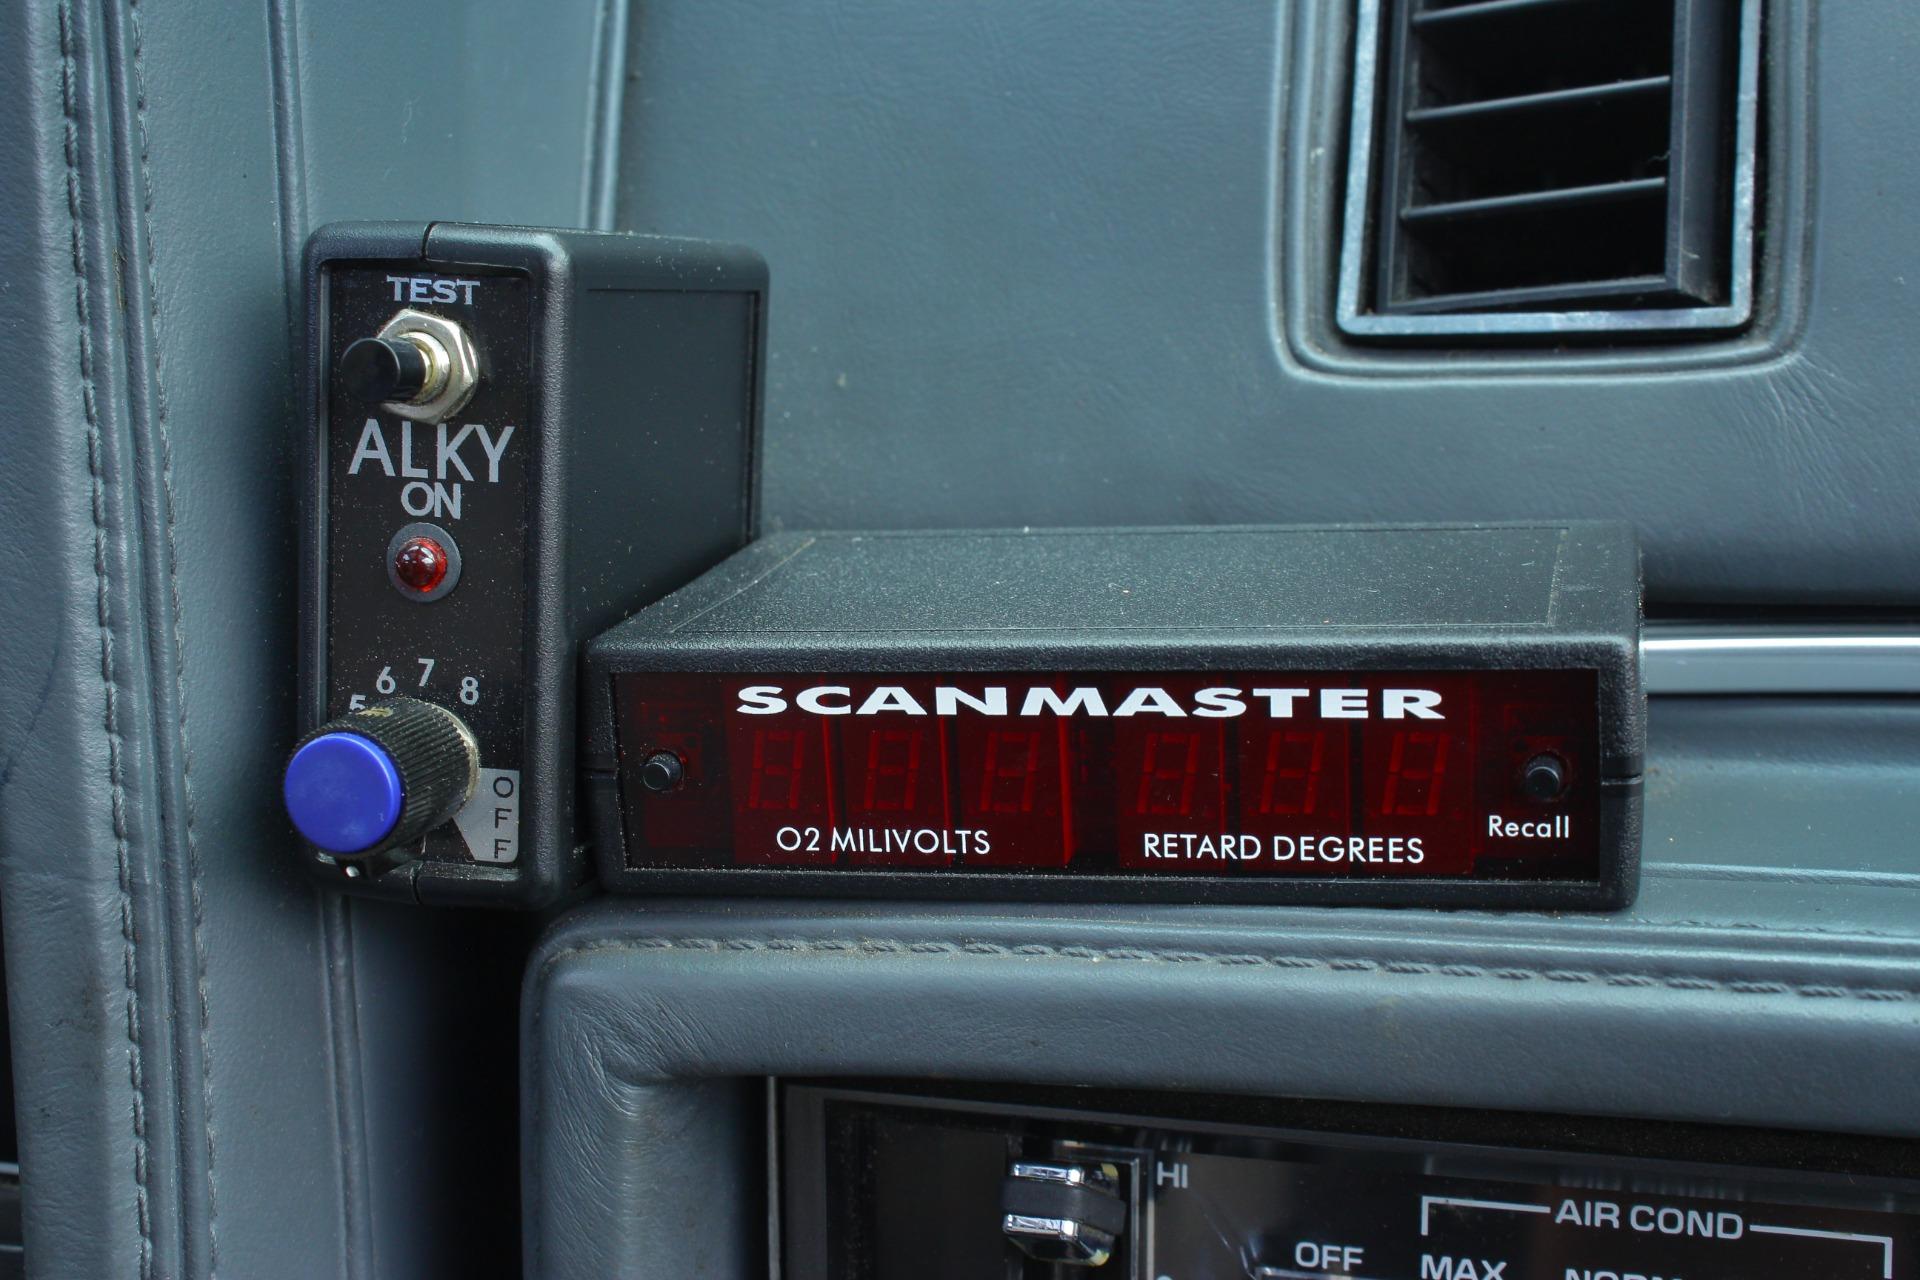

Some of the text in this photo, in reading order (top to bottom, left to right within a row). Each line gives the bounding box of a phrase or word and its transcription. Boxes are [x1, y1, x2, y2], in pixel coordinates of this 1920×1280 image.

[386, 274, 481, 305] TEST
[347, 418, 515, 483] ALKY
[400, 481, 462, 520] ON
[375, 666, 396, 694] 6
[417, 658, 435, 687] 7
[459, 676, 480, 706] 8
[736, 685, 1447, 720] SCANMASTER
[492, 776, 515, 860] OFF
[1487, 814, 1570, 839] Recall
[830, 827, 991, 855] MILIVOLTS
[1143, 832, 1425, 864] RETARD DEGREES
[1156, 1161, 1188, 1189] HI
[1554, 1199, 1744, 1240] AIR COND
[1295, 1241, 1364, 1272] OFF
[1421, 1253, 1508, 1280] MAX
